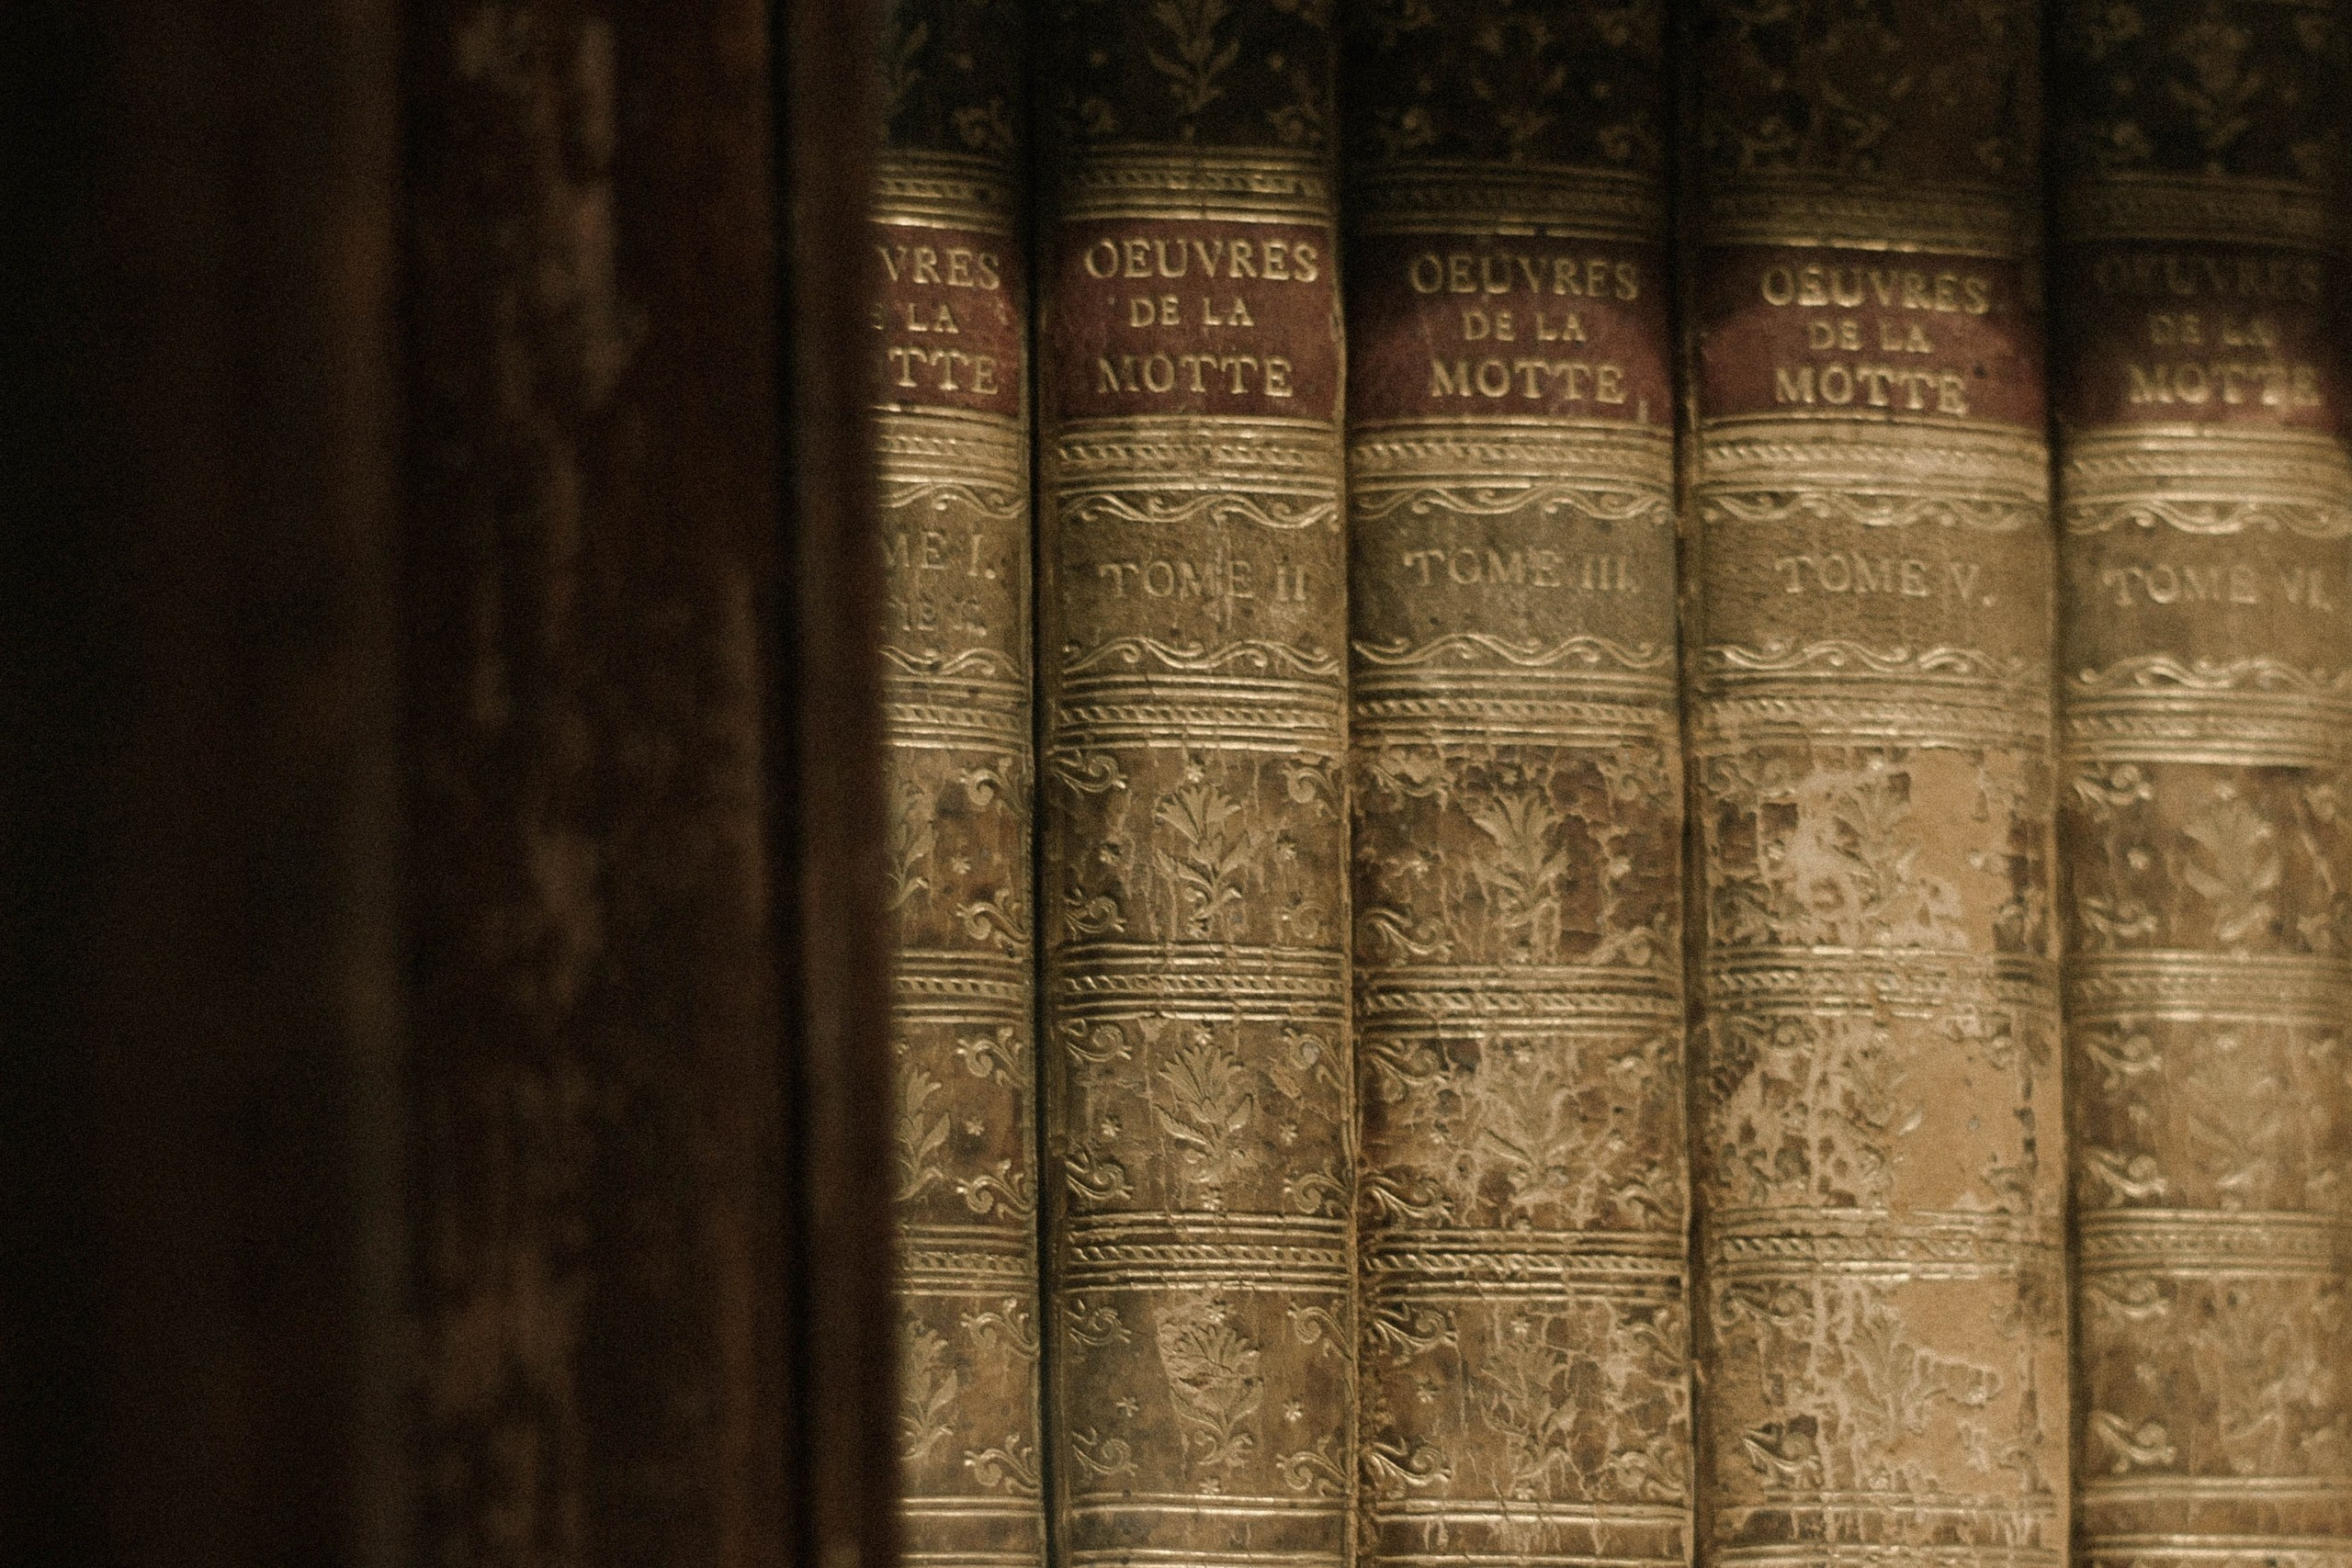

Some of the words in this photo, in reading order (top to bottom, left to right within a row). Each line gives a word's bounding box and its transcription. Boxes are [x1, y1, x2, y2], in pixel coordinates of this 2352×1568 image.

[1084, 237, 1318, 283] OEUVRES
[1410, 254, 1639, 301] OEUVRES
[1128, 295, 1180, 328] DE
[1201, 295, 1255, 327] LA
[1760, 266, 1991, 315] OEUVRES
[907, 301, 960, 334] LA
[1462, 310, 1515, 341] DE
[1535, 313, 1587, 342] LA
[1809, 319, 1861, 352] DE
[1878, 320, 1933, 354] LA
[1097, 353, 1294, 398] MOTTE
[1430, 359, 1626, 404] MOTTE
[1775, 366, 1970, 416] MOTTE
[2129, 363, 2322, 407] MOTTE
[1099, 560, 1257, 600] TOME
[1404, 549, 1563, 587] TOME
[1775, 555, 1928, 597] TOME
[2101, 565, 2259, 607] TOME
